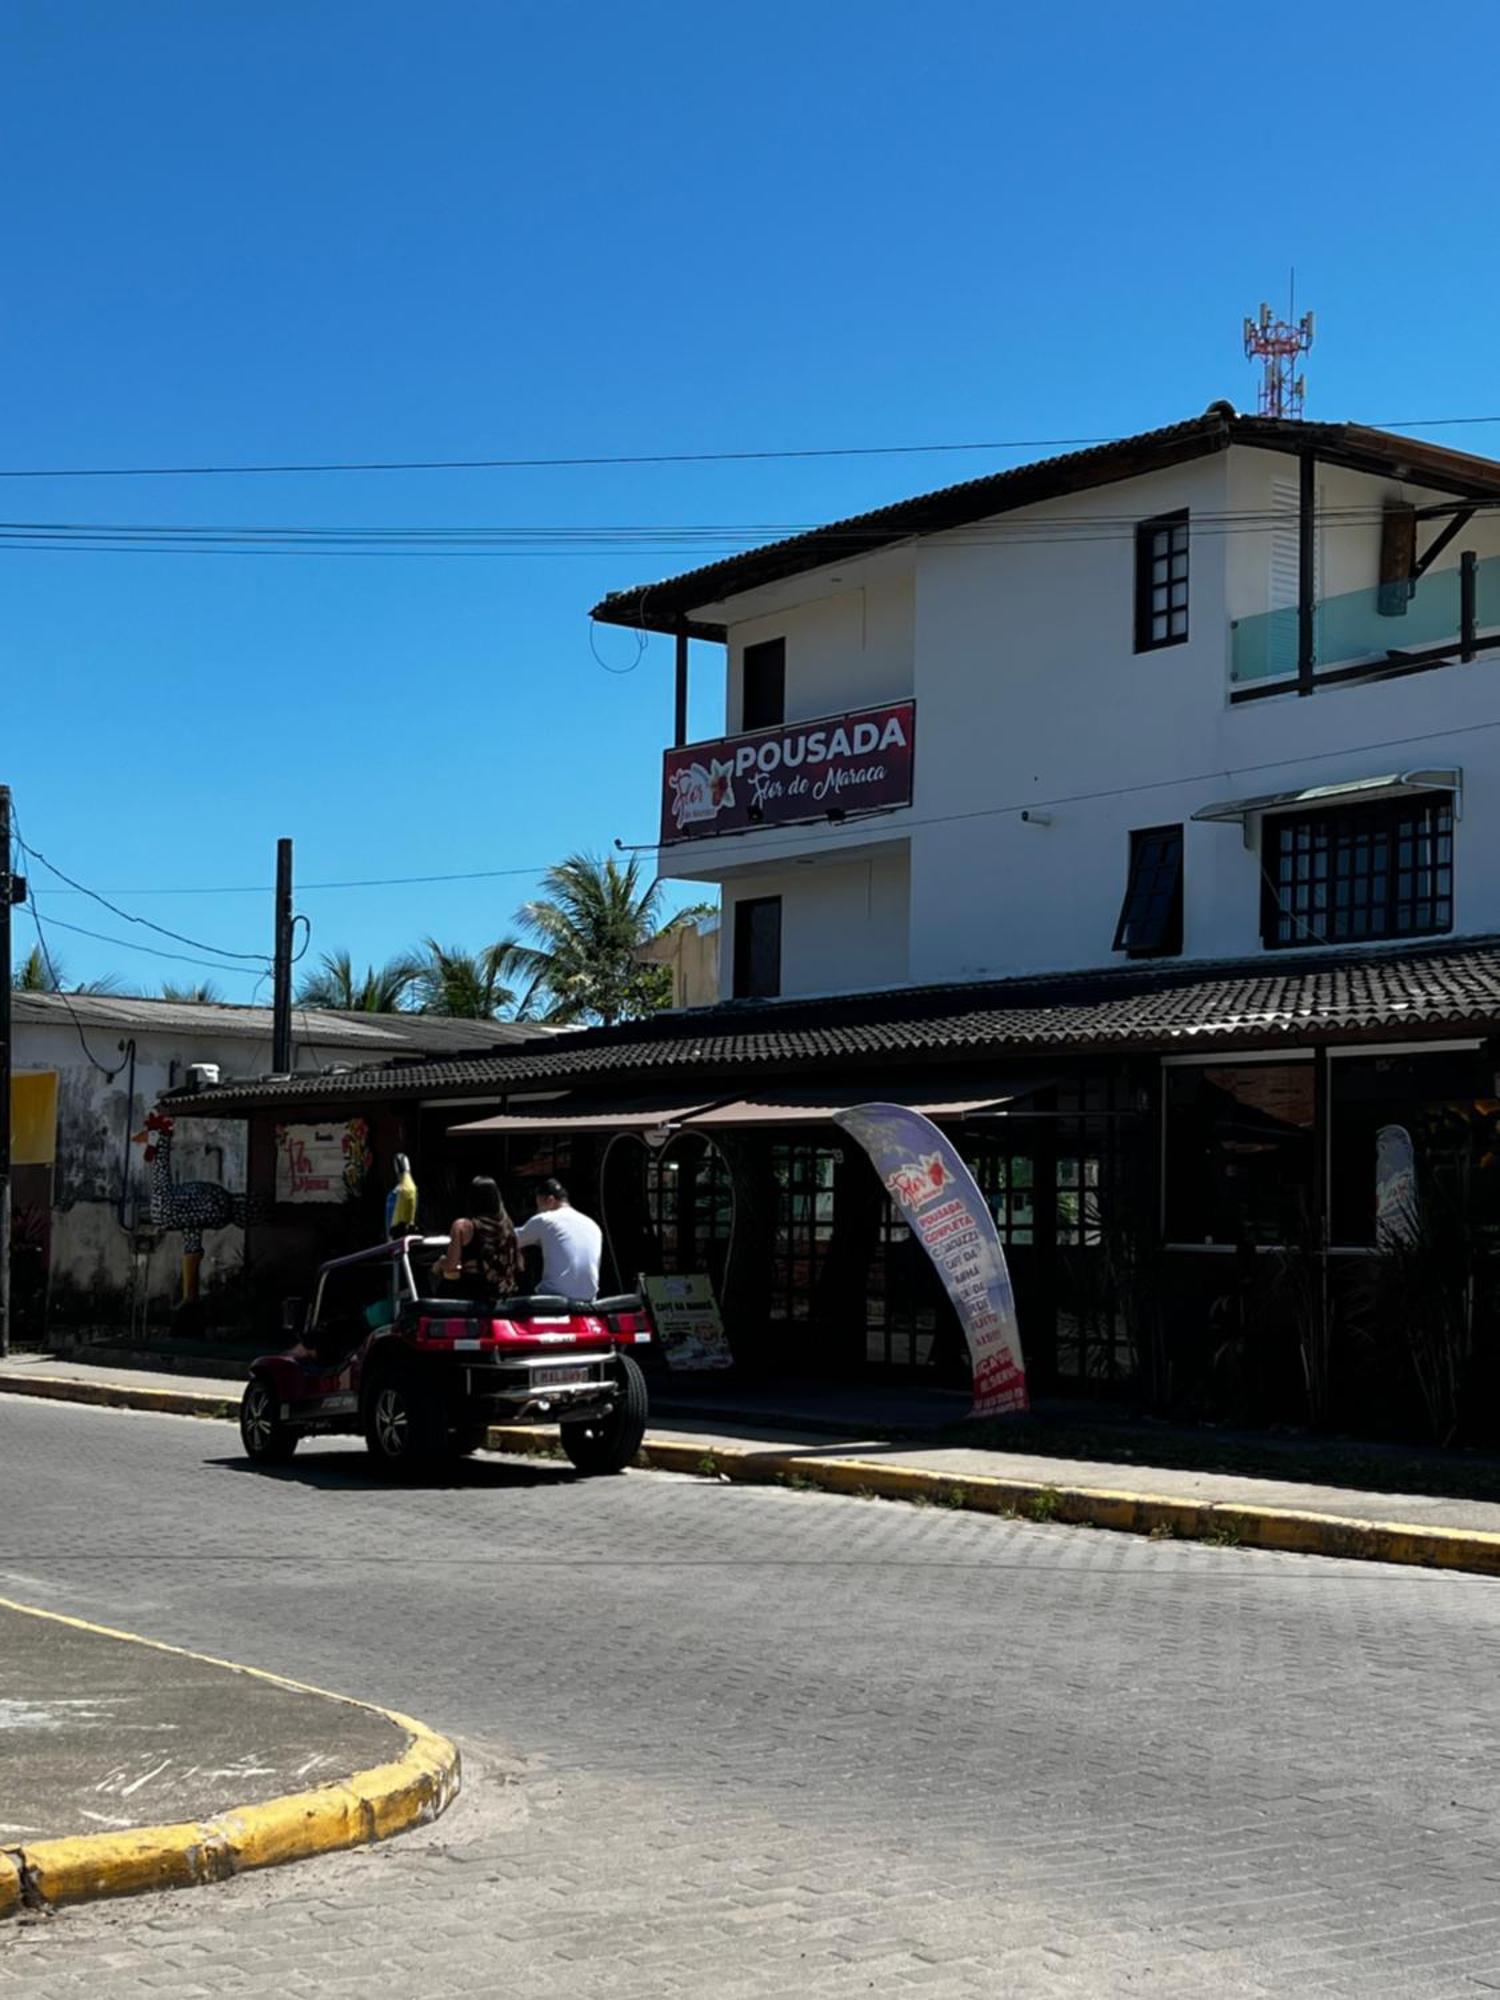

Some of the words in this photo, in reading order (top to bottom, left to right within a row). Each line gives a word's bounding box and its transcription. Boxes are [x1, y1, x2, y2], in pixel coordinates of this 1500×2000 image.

[736, 717, 907, 777] POUSADA
[747, 772, 784, 810] Flor
[788, 774, 809, 797] de
[919, 1200, 962, 1228] POUSADA
[924, 1215, 974, 1244] COMPLETA
